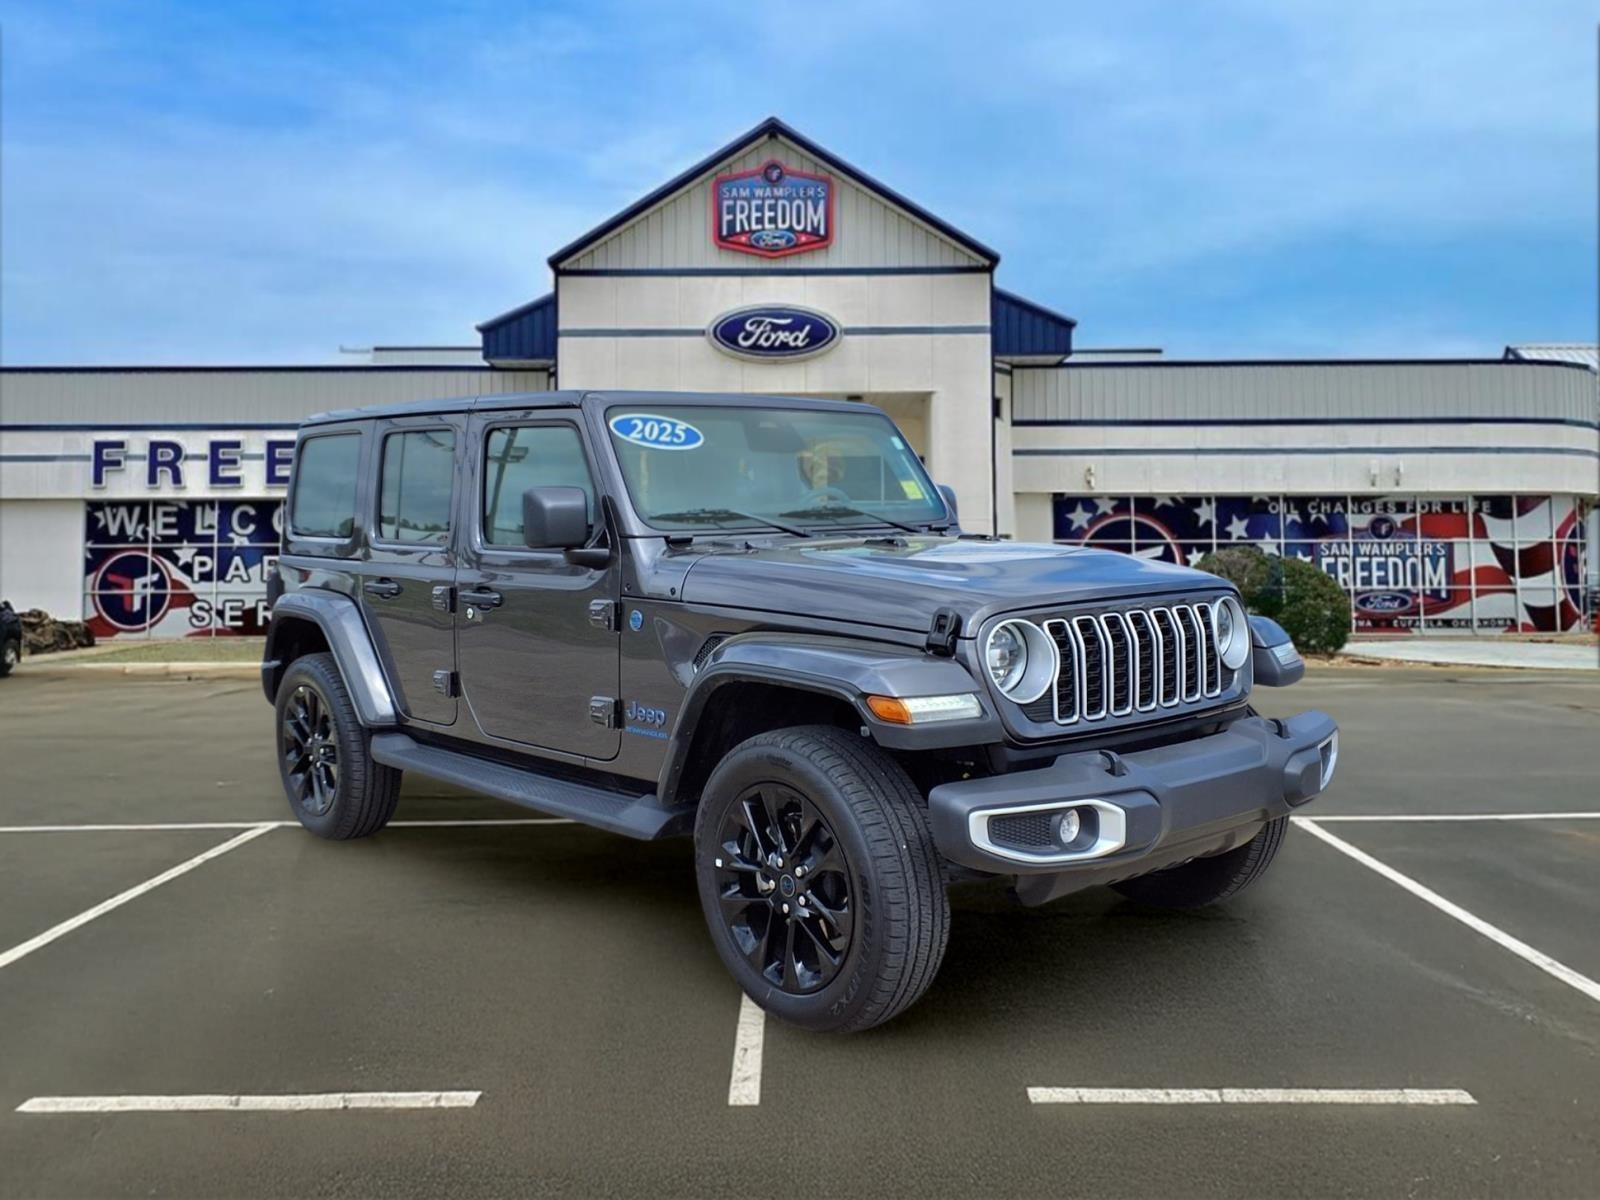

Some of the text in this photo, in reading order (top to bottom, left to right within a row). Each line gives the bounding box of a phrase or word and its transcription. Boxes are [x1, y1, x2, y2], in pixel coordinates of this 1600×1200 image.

[723, 188, 750, 198] SAM
[722, 199, 825, 236] FREEDOM
[759, 233, 788, 247] Ford
[738, 316, 811, 347] Ford
[629, 419, 686, 443] 2025
[93, 440, 297, 486] FREE
[1268, 501, 1491, 514] OIL CHANGES FOR LIFE
[1321, 557, 1447, 598] FREEDOM
[1365, 596, 1400, 609] Ford
[626, 701, 665, 728] Jeep
